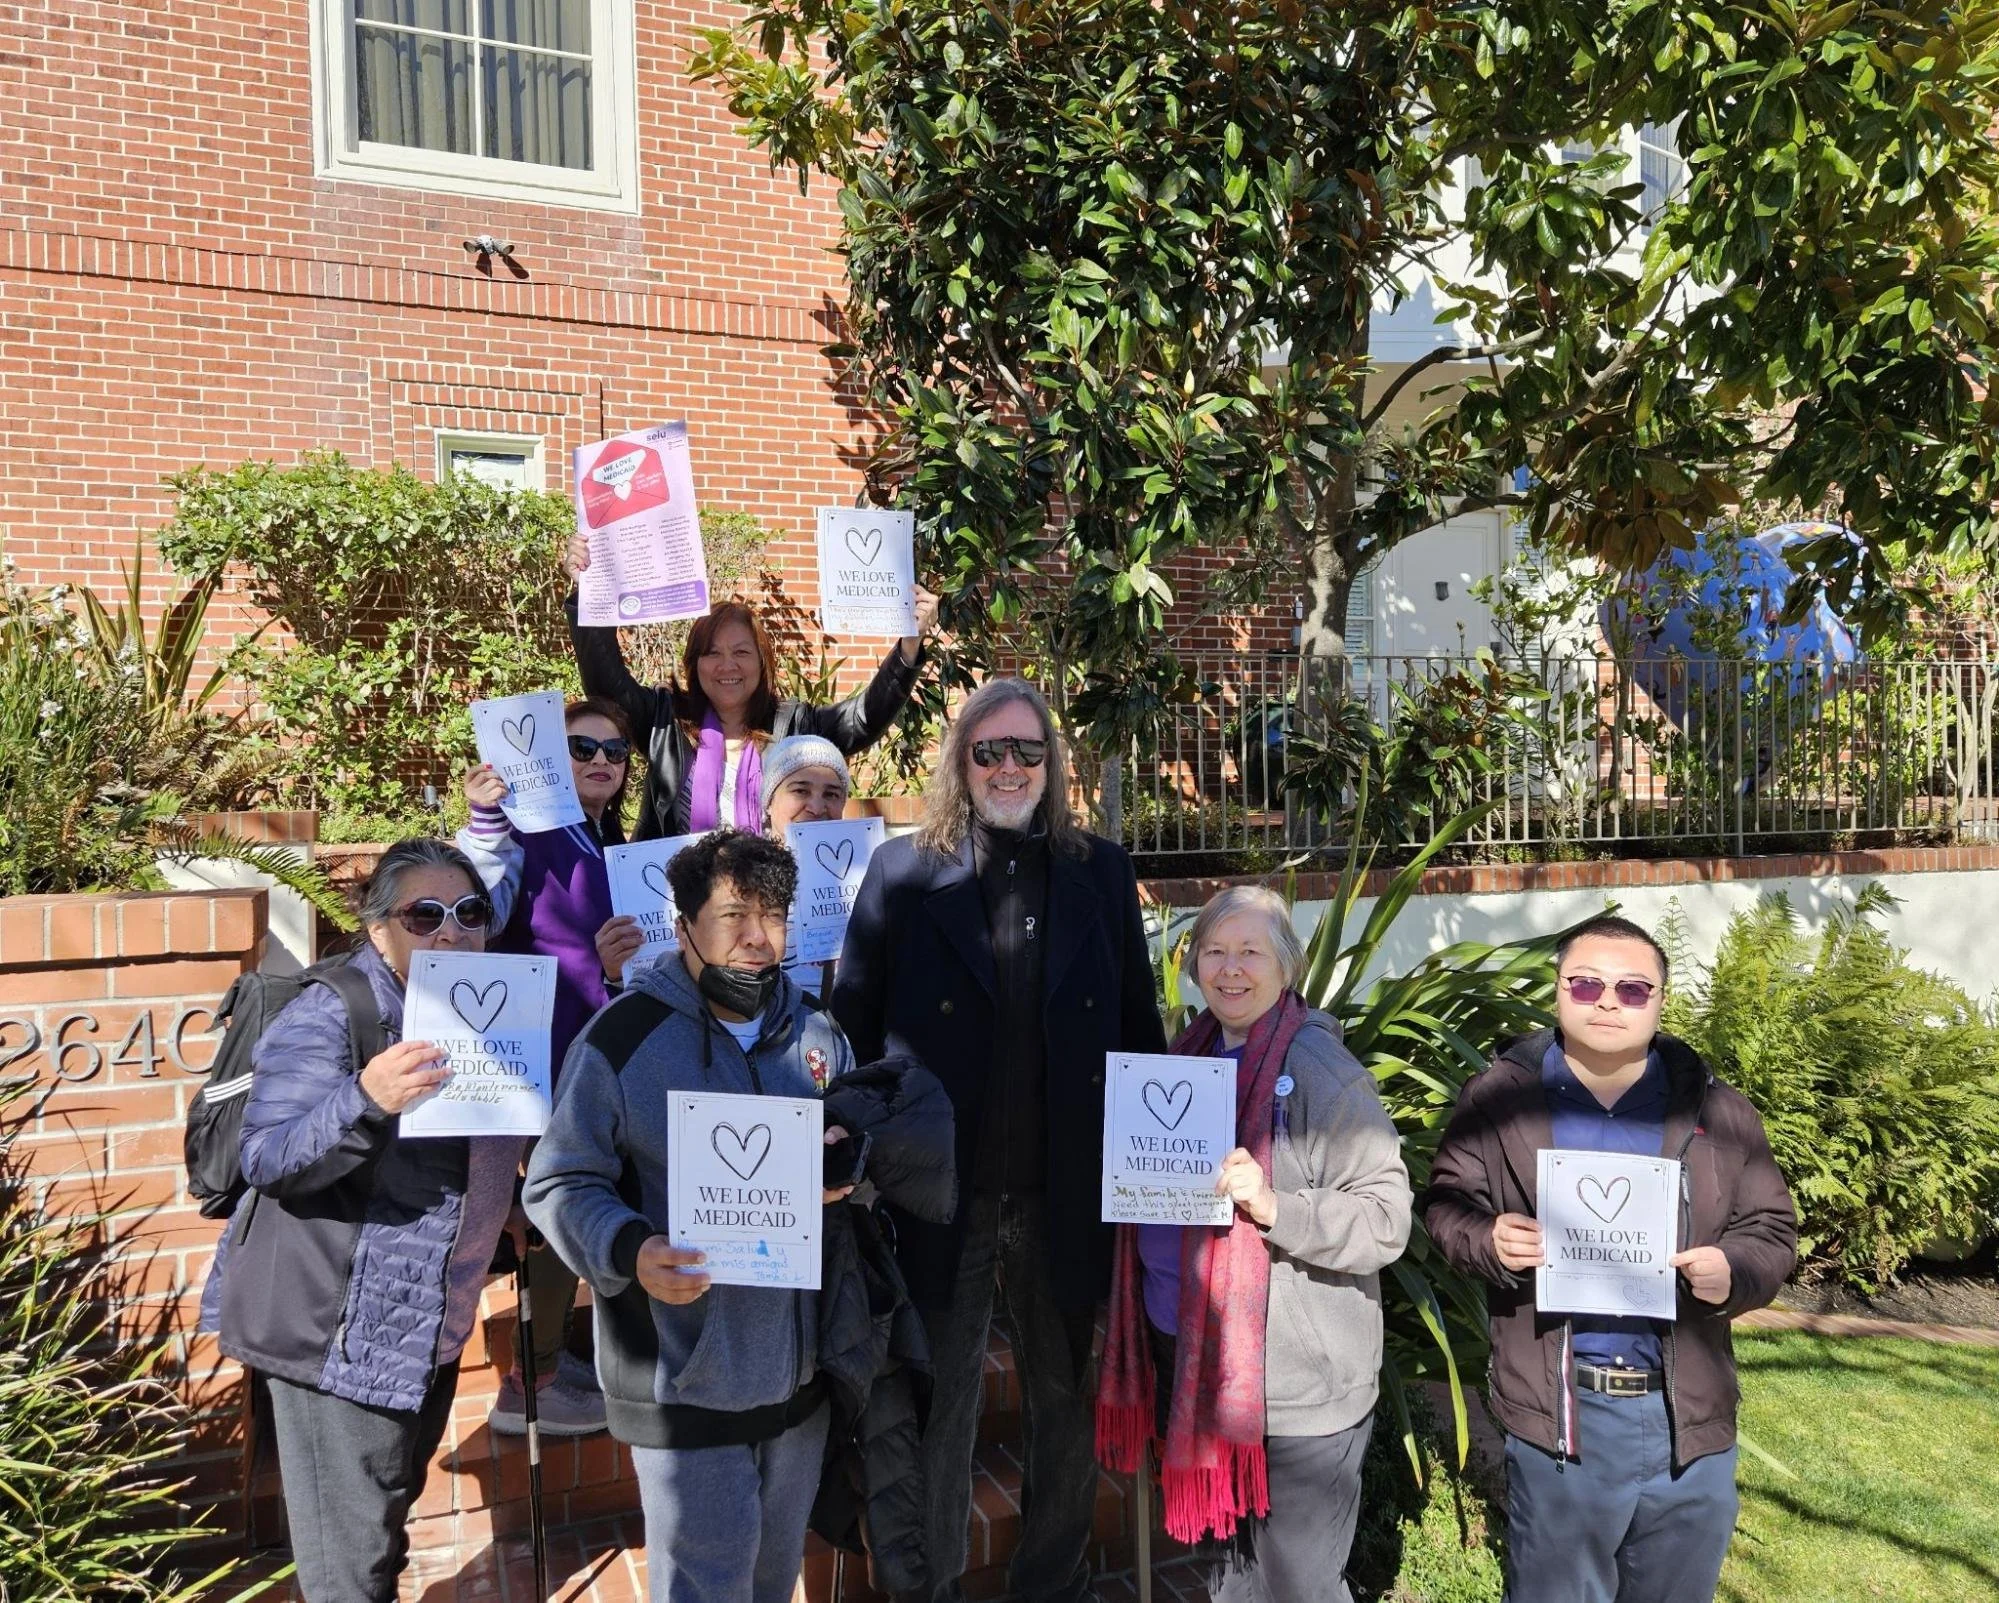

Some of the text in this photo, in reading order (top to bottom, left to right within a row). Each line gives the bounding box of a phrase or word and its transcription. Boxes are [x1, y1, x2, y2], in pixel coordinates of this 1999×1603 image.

[603, 457, 632, 473] WE LOVE
[603, 464, 636, 482] MEDICAID
[839, 570, 896, 583] WE LOVE
[836, 585, 900, 598] MEDICAID
[503, 757, 555, 778] WE LOVE
[812, 884, 859, 900] WE LO
[811, 901, 855, 917] MEDIC
[639, 911, 666, 926] WE
[435, 1039, 522, 1056] WE LOVE
[1130, 1136, 1209, 1155] WE LOVE
[1124, 1156, 1213, 1175] MEDICAID
[698, 1186, 791, 1206] WE LOVE
[1112, 1186, 1137, 1202] My
[693, 1208, 796, 1228] MEDICAID
[1565, 1228, 1648, 1245] WE LOVE
[1560, 1246, 1652, 1264] MEDICAID
